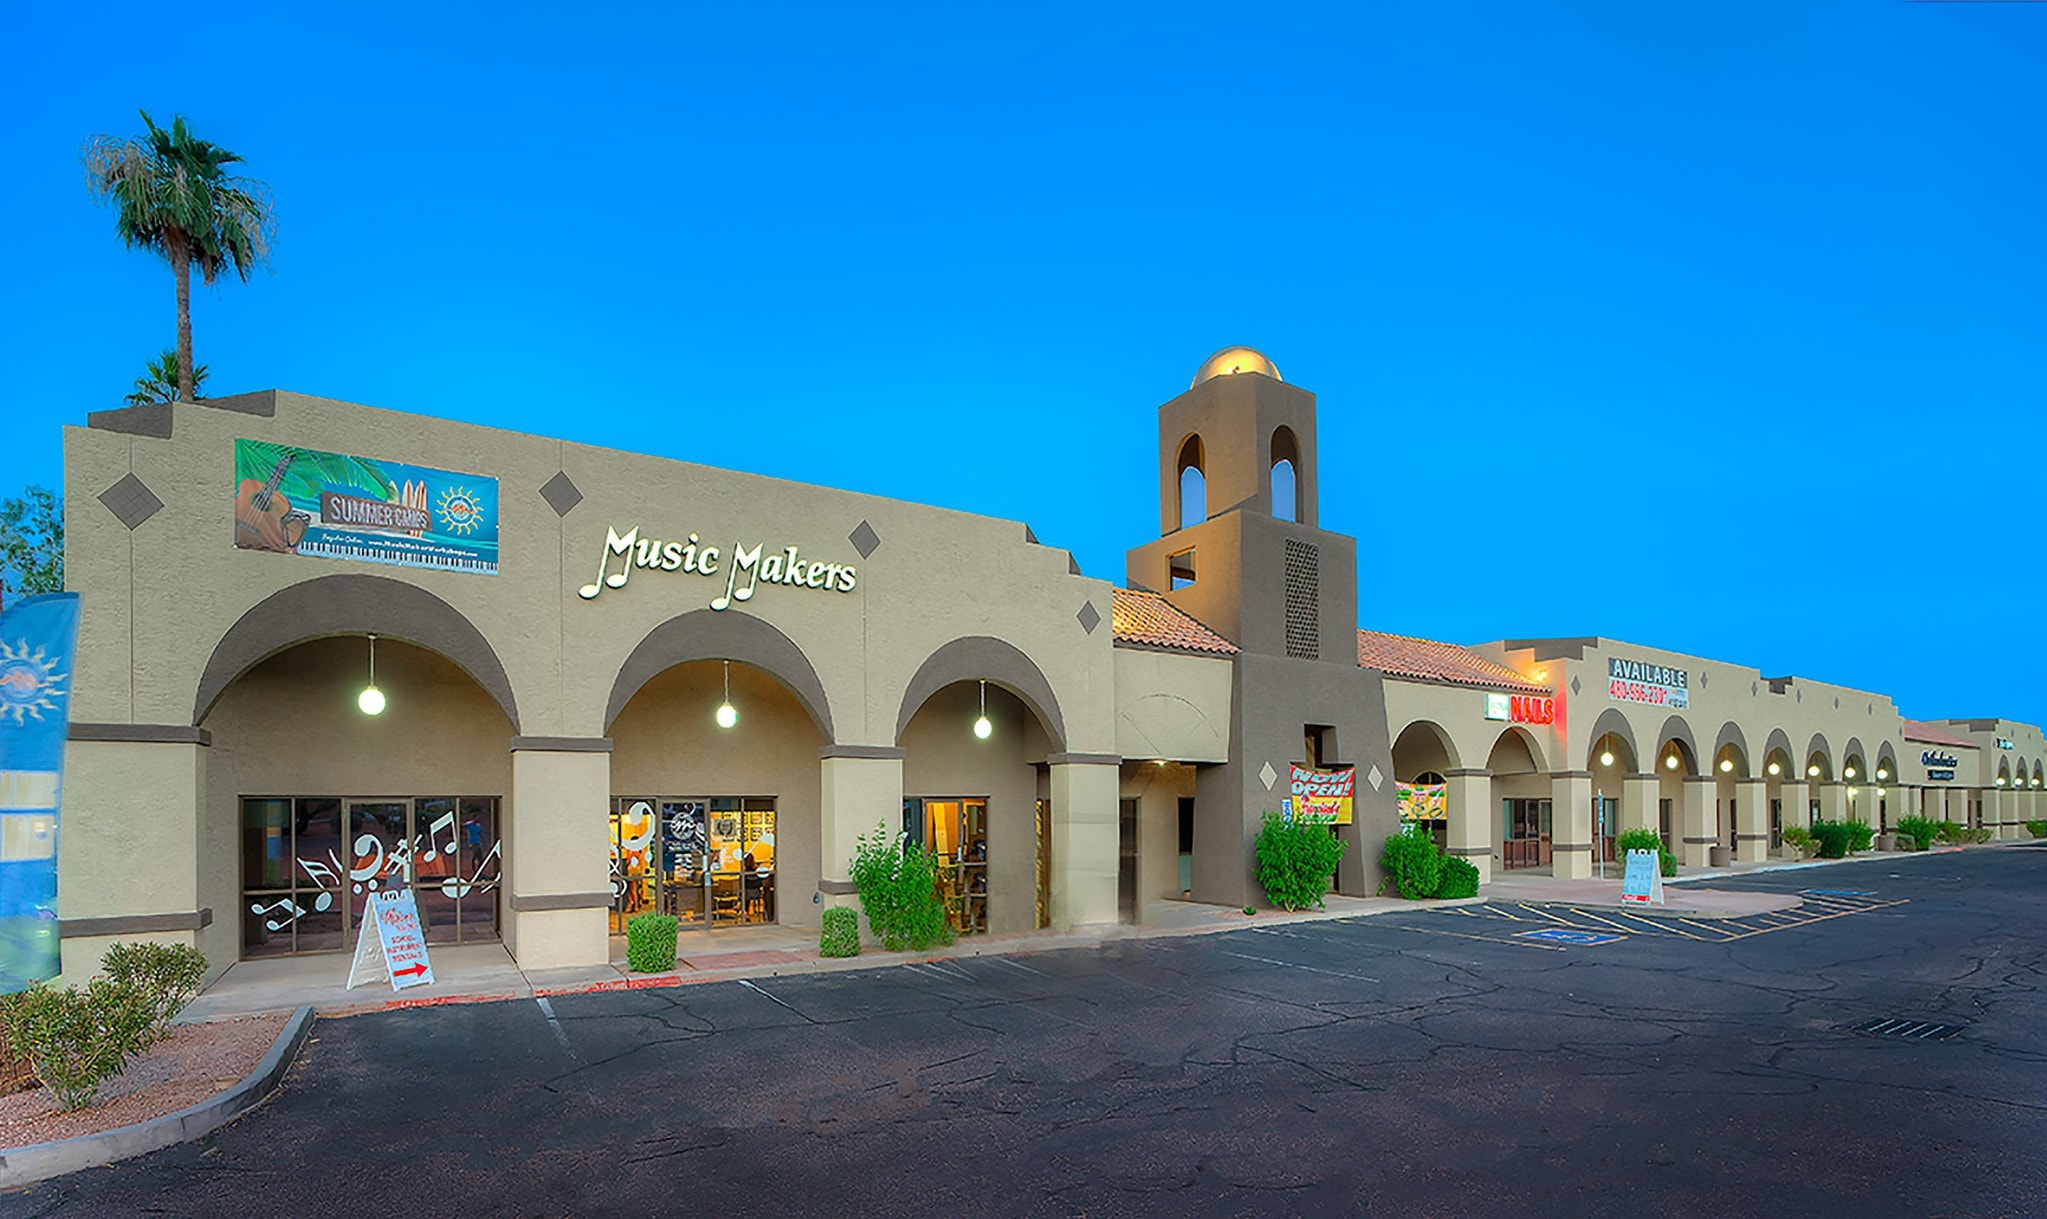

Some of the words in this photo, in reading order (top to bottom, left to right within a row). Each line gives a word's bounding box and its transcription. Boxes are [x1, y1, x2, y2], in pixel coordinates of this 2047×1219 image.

[330, 496, 393, 526] SUMMER
[395, 508, 428, 529] CAMPS
[577, 525, 720, 599] Music
[709, 542, 857, 611] Makers
[1613, 659, 1686, 688] AVAILABLE
[1510, 695, 1553, 725] NAILS
[1291, 781, 1352, 797] OPEN!
[1292, 768, 1353, 784] NOW
